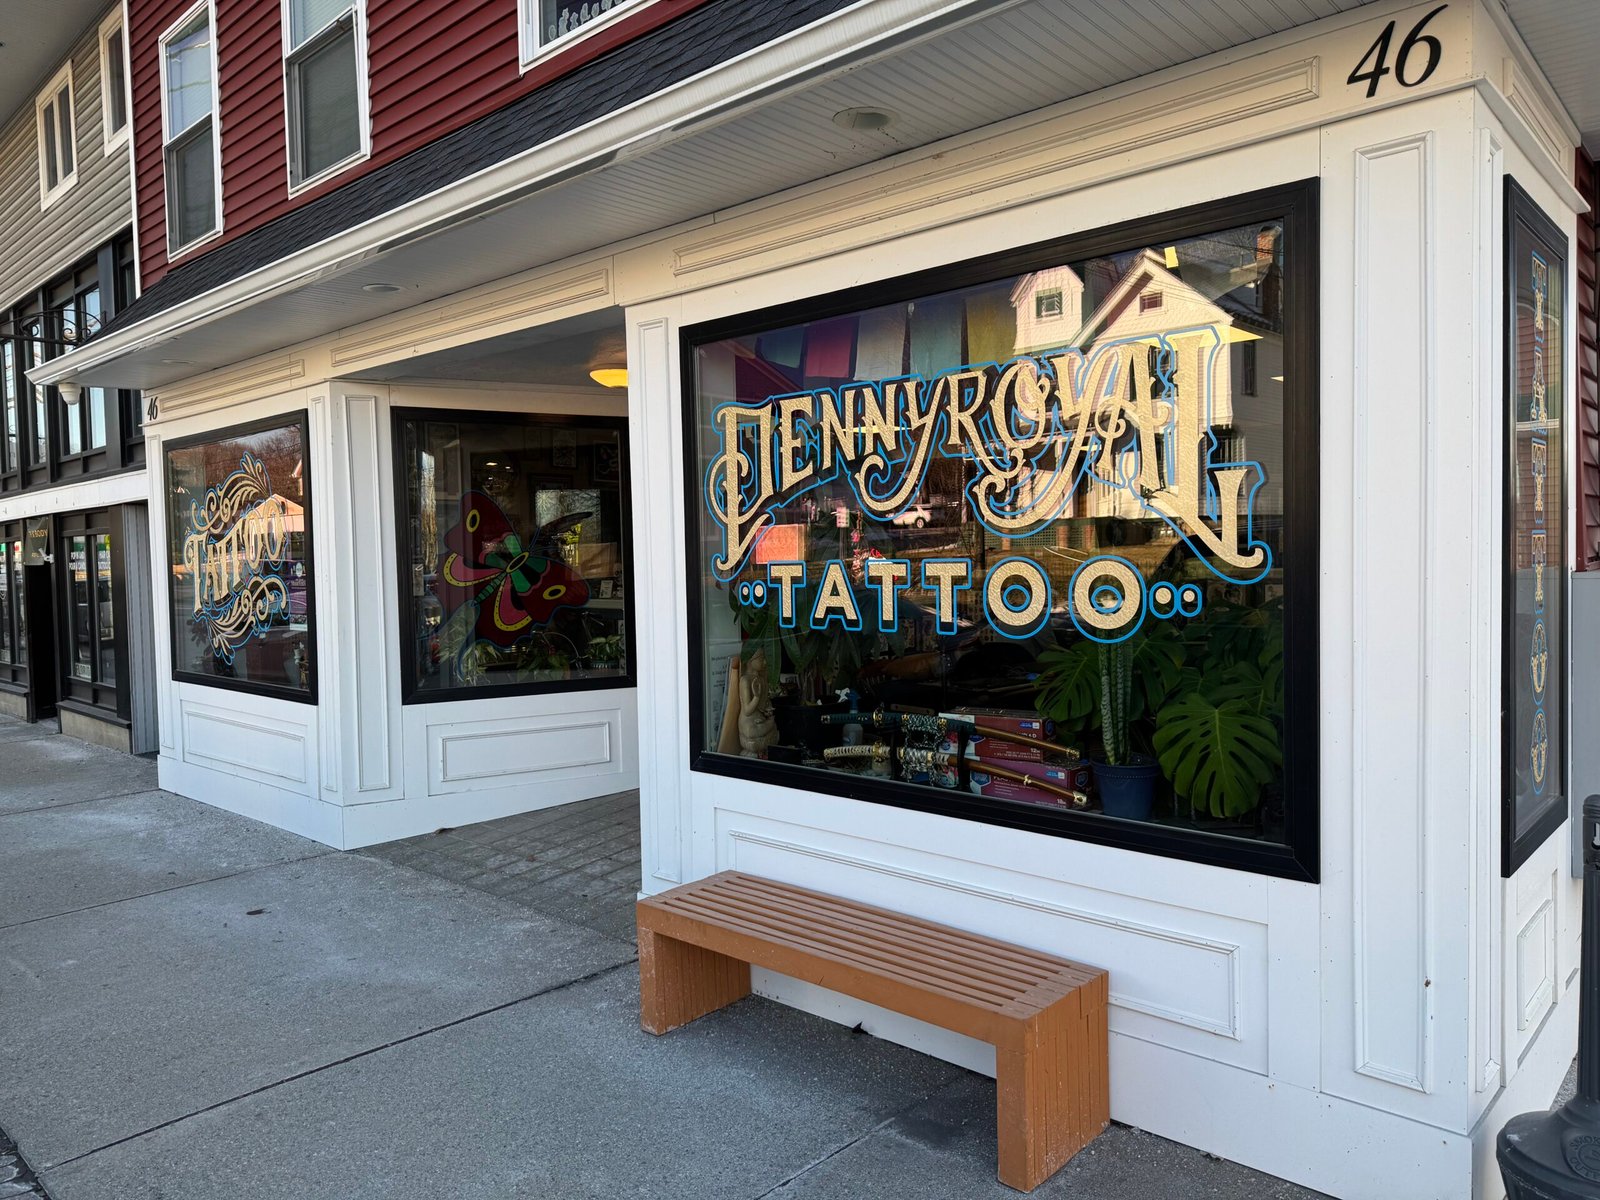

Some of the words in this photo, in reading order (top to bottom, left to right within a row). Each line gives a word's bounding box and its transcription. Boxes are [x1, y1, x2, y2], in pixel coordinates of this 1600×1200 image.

[1347, 3, 1448, 98] 46
[148, 396, 158, 421] 46
[706, 326, 1271, 580] PENNYROYAL
[184, 499, 286, 619] TATTOO
[1531, 251, 1548, 793] TATTOO
[767, 557, 1145, 641] TATTOO
